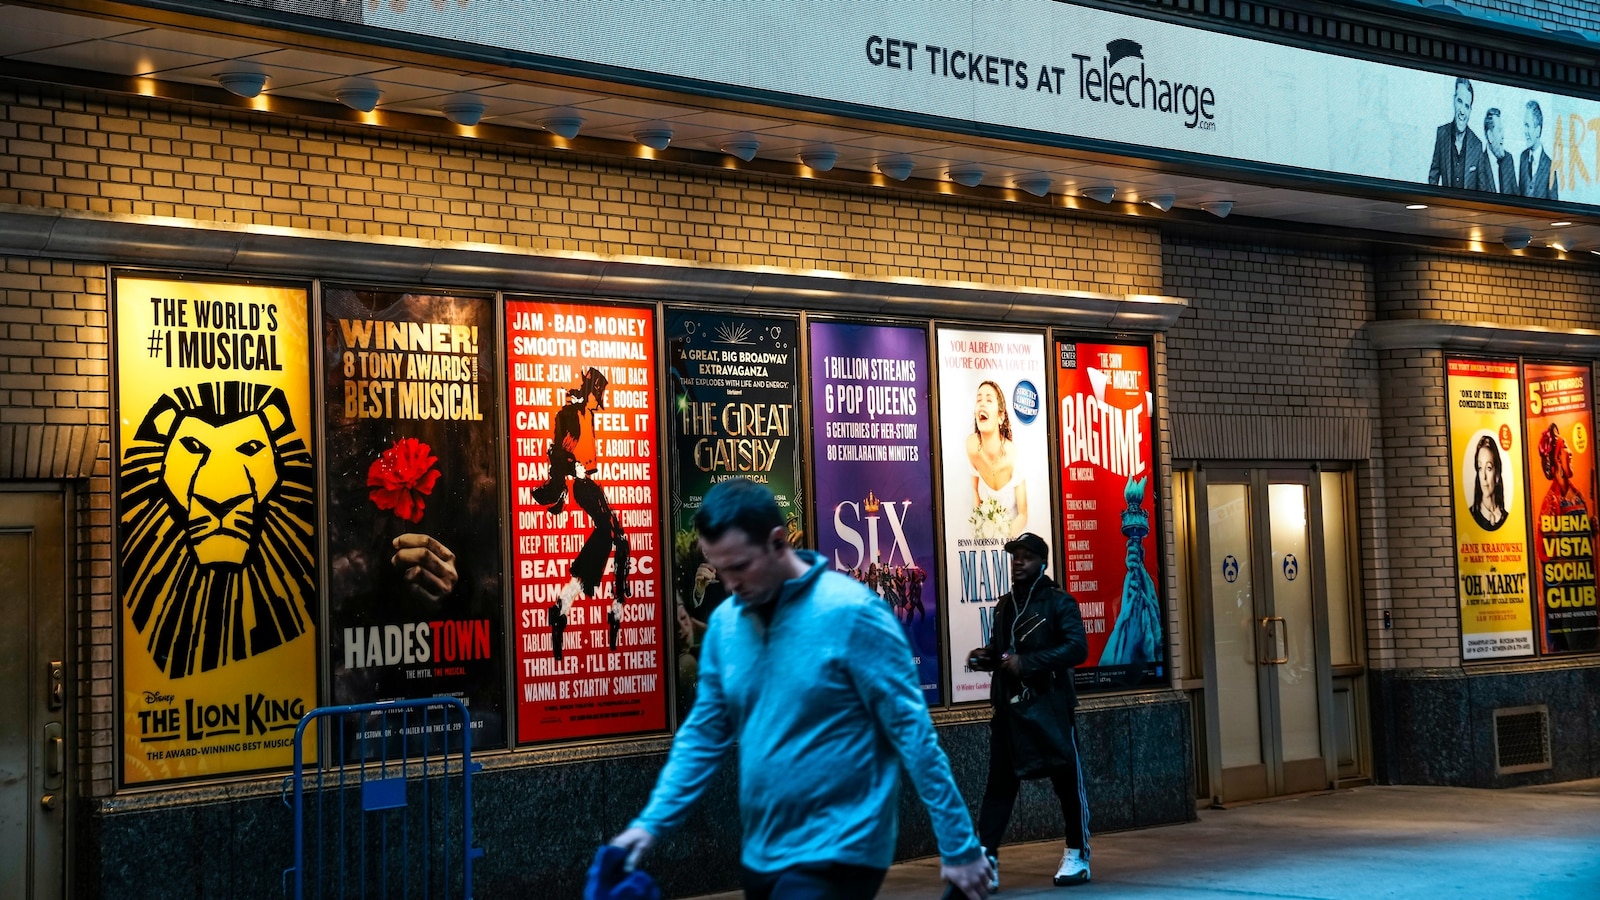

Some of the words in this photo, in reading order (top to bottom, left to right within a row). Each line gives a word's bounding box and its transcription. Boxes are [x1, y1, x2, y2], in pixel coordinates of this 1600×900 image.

[866, 35, 917, 71] GET
[926, 45, 1028, 89] TICKETS
[1036, 65, 1065, 94] AT
[1072, 53, 1215, 128] Telecharge
[1198, 120, 1216, 131] .com
[151, 298, 188, 327] THE
[194, 300, 278, 331] WORLD'S
[513, 312, 544, 331] JAM
[554, 314, 586, 333] BAD
[594, 316, 646, 336] MONEY
[339, 319, 478, 354] WINNER!
[147, 330, 172, 367] #1
[179, 331, 283, 371] MUSICAL
[514, 336, 577, 357] SMOOTH
[580, 340, 647, 360] CRIMINAL
[689, 350, 720, 362] GREAT,
[722, 351, 737, 361] BIG
[740, 352, 788, 364] BROADWAY
[950, 340, 966, 352] YOU
[969, 341, 1005, 354] ALREADY
[1007, 343, 1031, 355] KNOW
[344, 351, 355, 378] 8
[359, 352, 403, 379] TONY
[514, 363, 544, 382] BILLIE
[547, 364, 571, 382] JEAN
[611, 367, 626, 385] YOU
[629, 367, 648, 385] BACK
[699, 364, 768, 377] EXTRAVAGANZA
[824, 356, 829, 378] 1
[831, 357, 869, 380] BILLION
[871, 359, 915, 382] STREAMS
[944, 356, 972, 369] YOU'RE
[975, 357, 1003, 370] GONNA
[1006, 359, 1025, 371] LOVE
[1027, 360, 1038, 371] IT!
[696, 378, 724, 386] EXPLODES
[726, 379, 740, 387] WITH
[344, 380, 394, 419] BEST
[398, 382, 483, 421] MUSICAL
[515, 387, 552, 406] BLAME
[557, 388, 566, 406] IT
[614, 390, 648, 408] BOOGIE
[825, 384, 834, 414] 6
[837, 385, 863, 414] POP
[867, 385, 916, 420] QUEENS
[1459, 400, 1485, 408] COMEDIES
[1482, 391, 1493, 399] THE
[1494, 392, 1507, 400] BEST
[1529, 382, 1542, 414] 5
[1541, 380, 1558, 392] TONY
[1558, 377, 1584, 390] AWARDS
[516, 411, 549, 430] CAN
[594, 413, 629, 431] FEEL
[635, 414, 648, 431] IT
[682, 402, 717, 435] THE
[722, 402, 792, 436] GREAT
[826, 422, 831, 438] 5
[833, 422, 869, 439] CENTURIES
[871, 423, 879, 439] OF
[881, 423, 917, 439] HER-STORY
[1062, 392, 1146, 477] RAGTIME
[517, 438, 546, 456] THEY
[606, 439, 635, 457] ABOUT
[638, 440, 650, 457] US
[694, 438, 780, 472] GATSBY
[827, 445, 837, 461] 80
[838, 445, 887, 461] EXHILARATING
[888, 445, 919, 462] MINUTES
[591, 463, 650, 481] MACHINE
[710, 475, 716, 484] A
[1077, 468, 1094, 481] MUSICAL
[604, 486, 651, 504] MIRROR
[519, 511, 544, 530] DON'T
[546, 511, 568, 529] STOP
[570, 511, 585, 528] 'TIL
[622, 509, 652, 527] ENOUGH
[1541, 514, 1591, 532] BUENA
[520, 535, 540, 554] KEEP
[543, 535, 559, 553] THE
[561, 534, 585, 553] FAITH
[630, 533, 653, 551] WHITE
[834, 500, 919, 571] SIX
[973, 538, 999, 546] ANDERSSON
[1461, 543, 1479, 554] JANE
[1482, 543, 1523, 553] KRAKOWSKI
[1543, 537, 1592, 558] VISTA
[521, 559, 569, 578] BEAT
[1486, 555, 1499, 563] TODD
[959, 550, 1010, 603] MAM
[1545, 562, 1594, 582] SOCIAL
[1547, 586, 1597, 608] CLUB
[590, 606, 602, 624] IN
[344, 619, 491, 669] HADESTOWN
[522, 633, 553, 652] TABLOID
[590, 629, 604, 648] THE
[624, 628, 638, 646] YOU
[639, 627, 656, 645] SAVE
[406, 670, 415, 679] THE
[417, 669, 432, 678] MYTH.
[434, 668, 442, 676] THE
[523, 656, 578, 677] THRILLER
[587, 654, 605, 672] I'LL
[608, 653, 621, 671] BE
[623, 650, 657, 670] THERE
[524, 682, 557, 702] WANNA
[559, 680, 570, 699] BE
[573, 678, 610, 698] STARTIN'
[613, 674, 657, 695] SOMETHIN'
[961, 683, 974, 691] Winter
[143, 691, 175, 705] Disney
[138, 708, 180, 734] THE
[185, 699, 240, 741] LION
[245, 693, 305, 736] KING
[147, 752, 163, 760] THE
[166, 744, 241, 759] AWARD-WINNING
[243, 741, 261, 751] BEST
[264, 738, 295, 749] MUSICA
